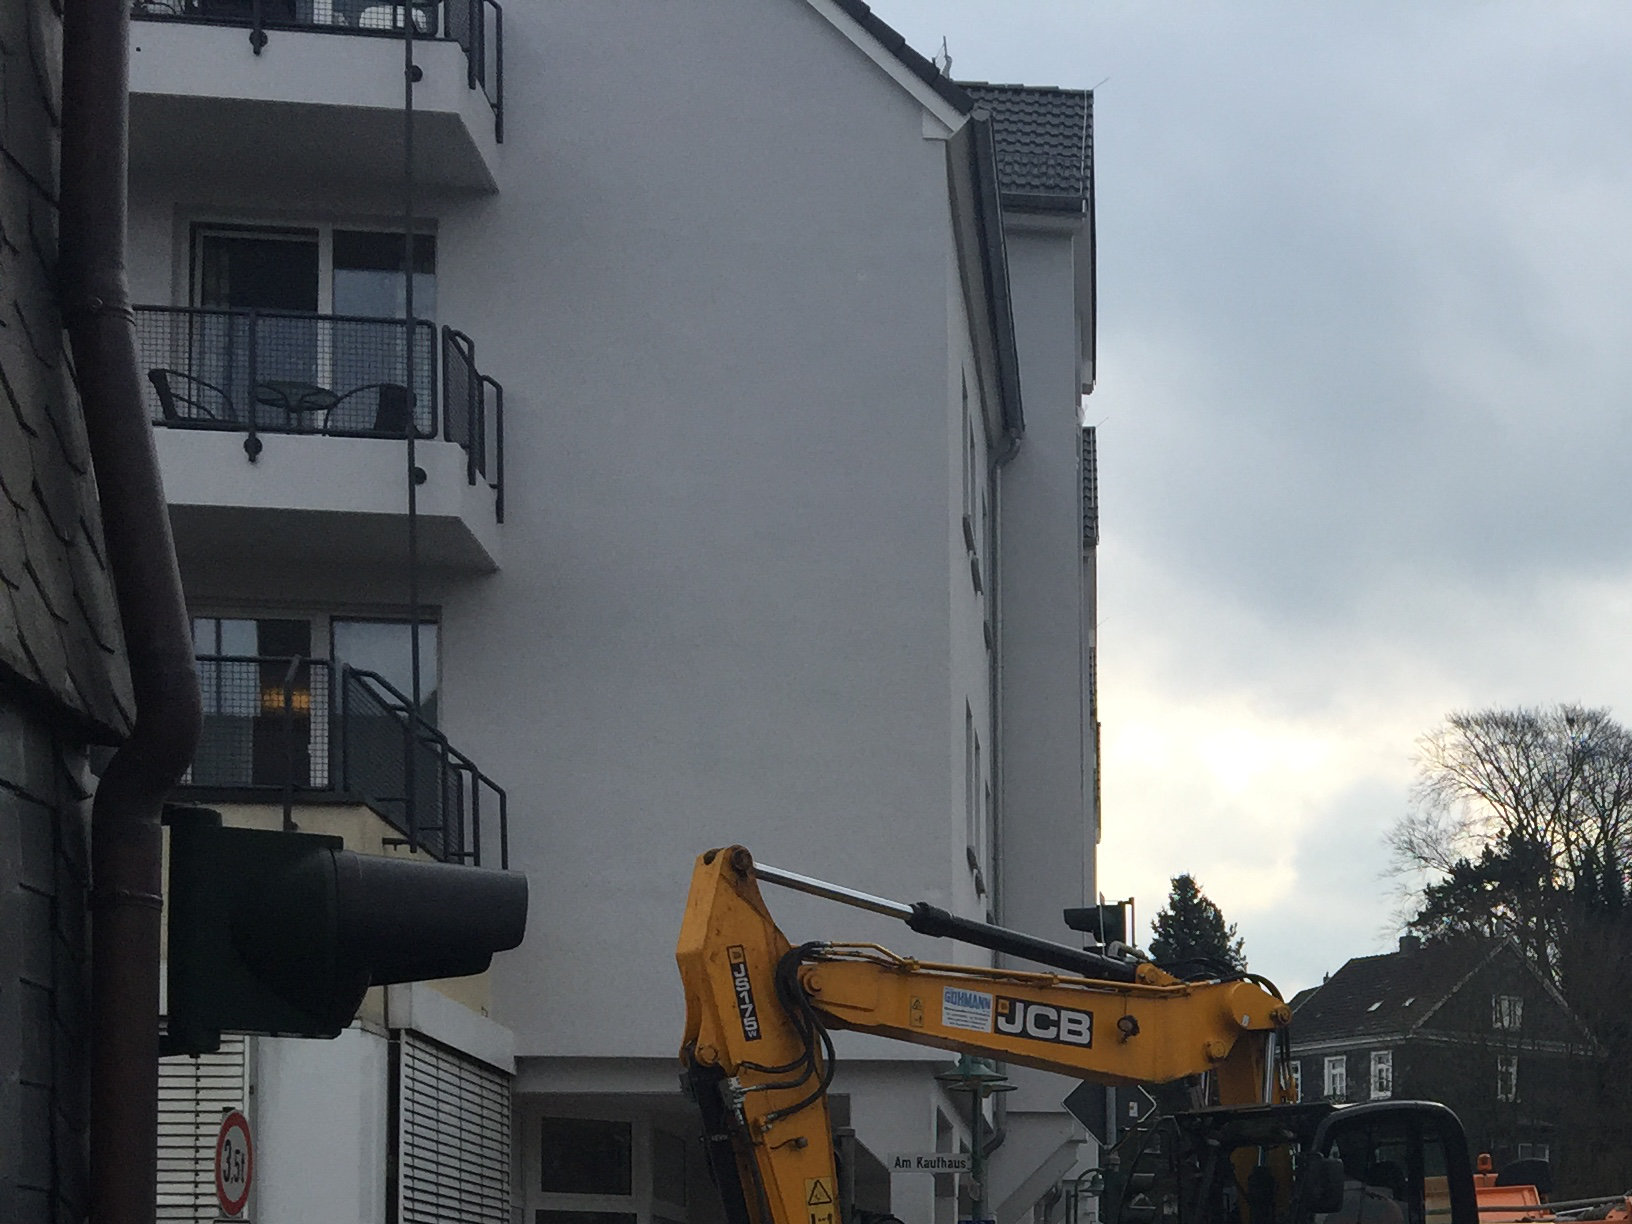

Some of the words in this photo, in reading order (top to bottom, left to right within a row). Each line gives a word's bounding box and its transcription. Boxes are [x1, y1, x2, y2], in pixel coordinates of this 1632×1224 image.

[997, 1001, 1091, 1044] JCB
[894, 1156, 911, 1168] Am
[916, 1156, 967, 1168] Kaufhaus
